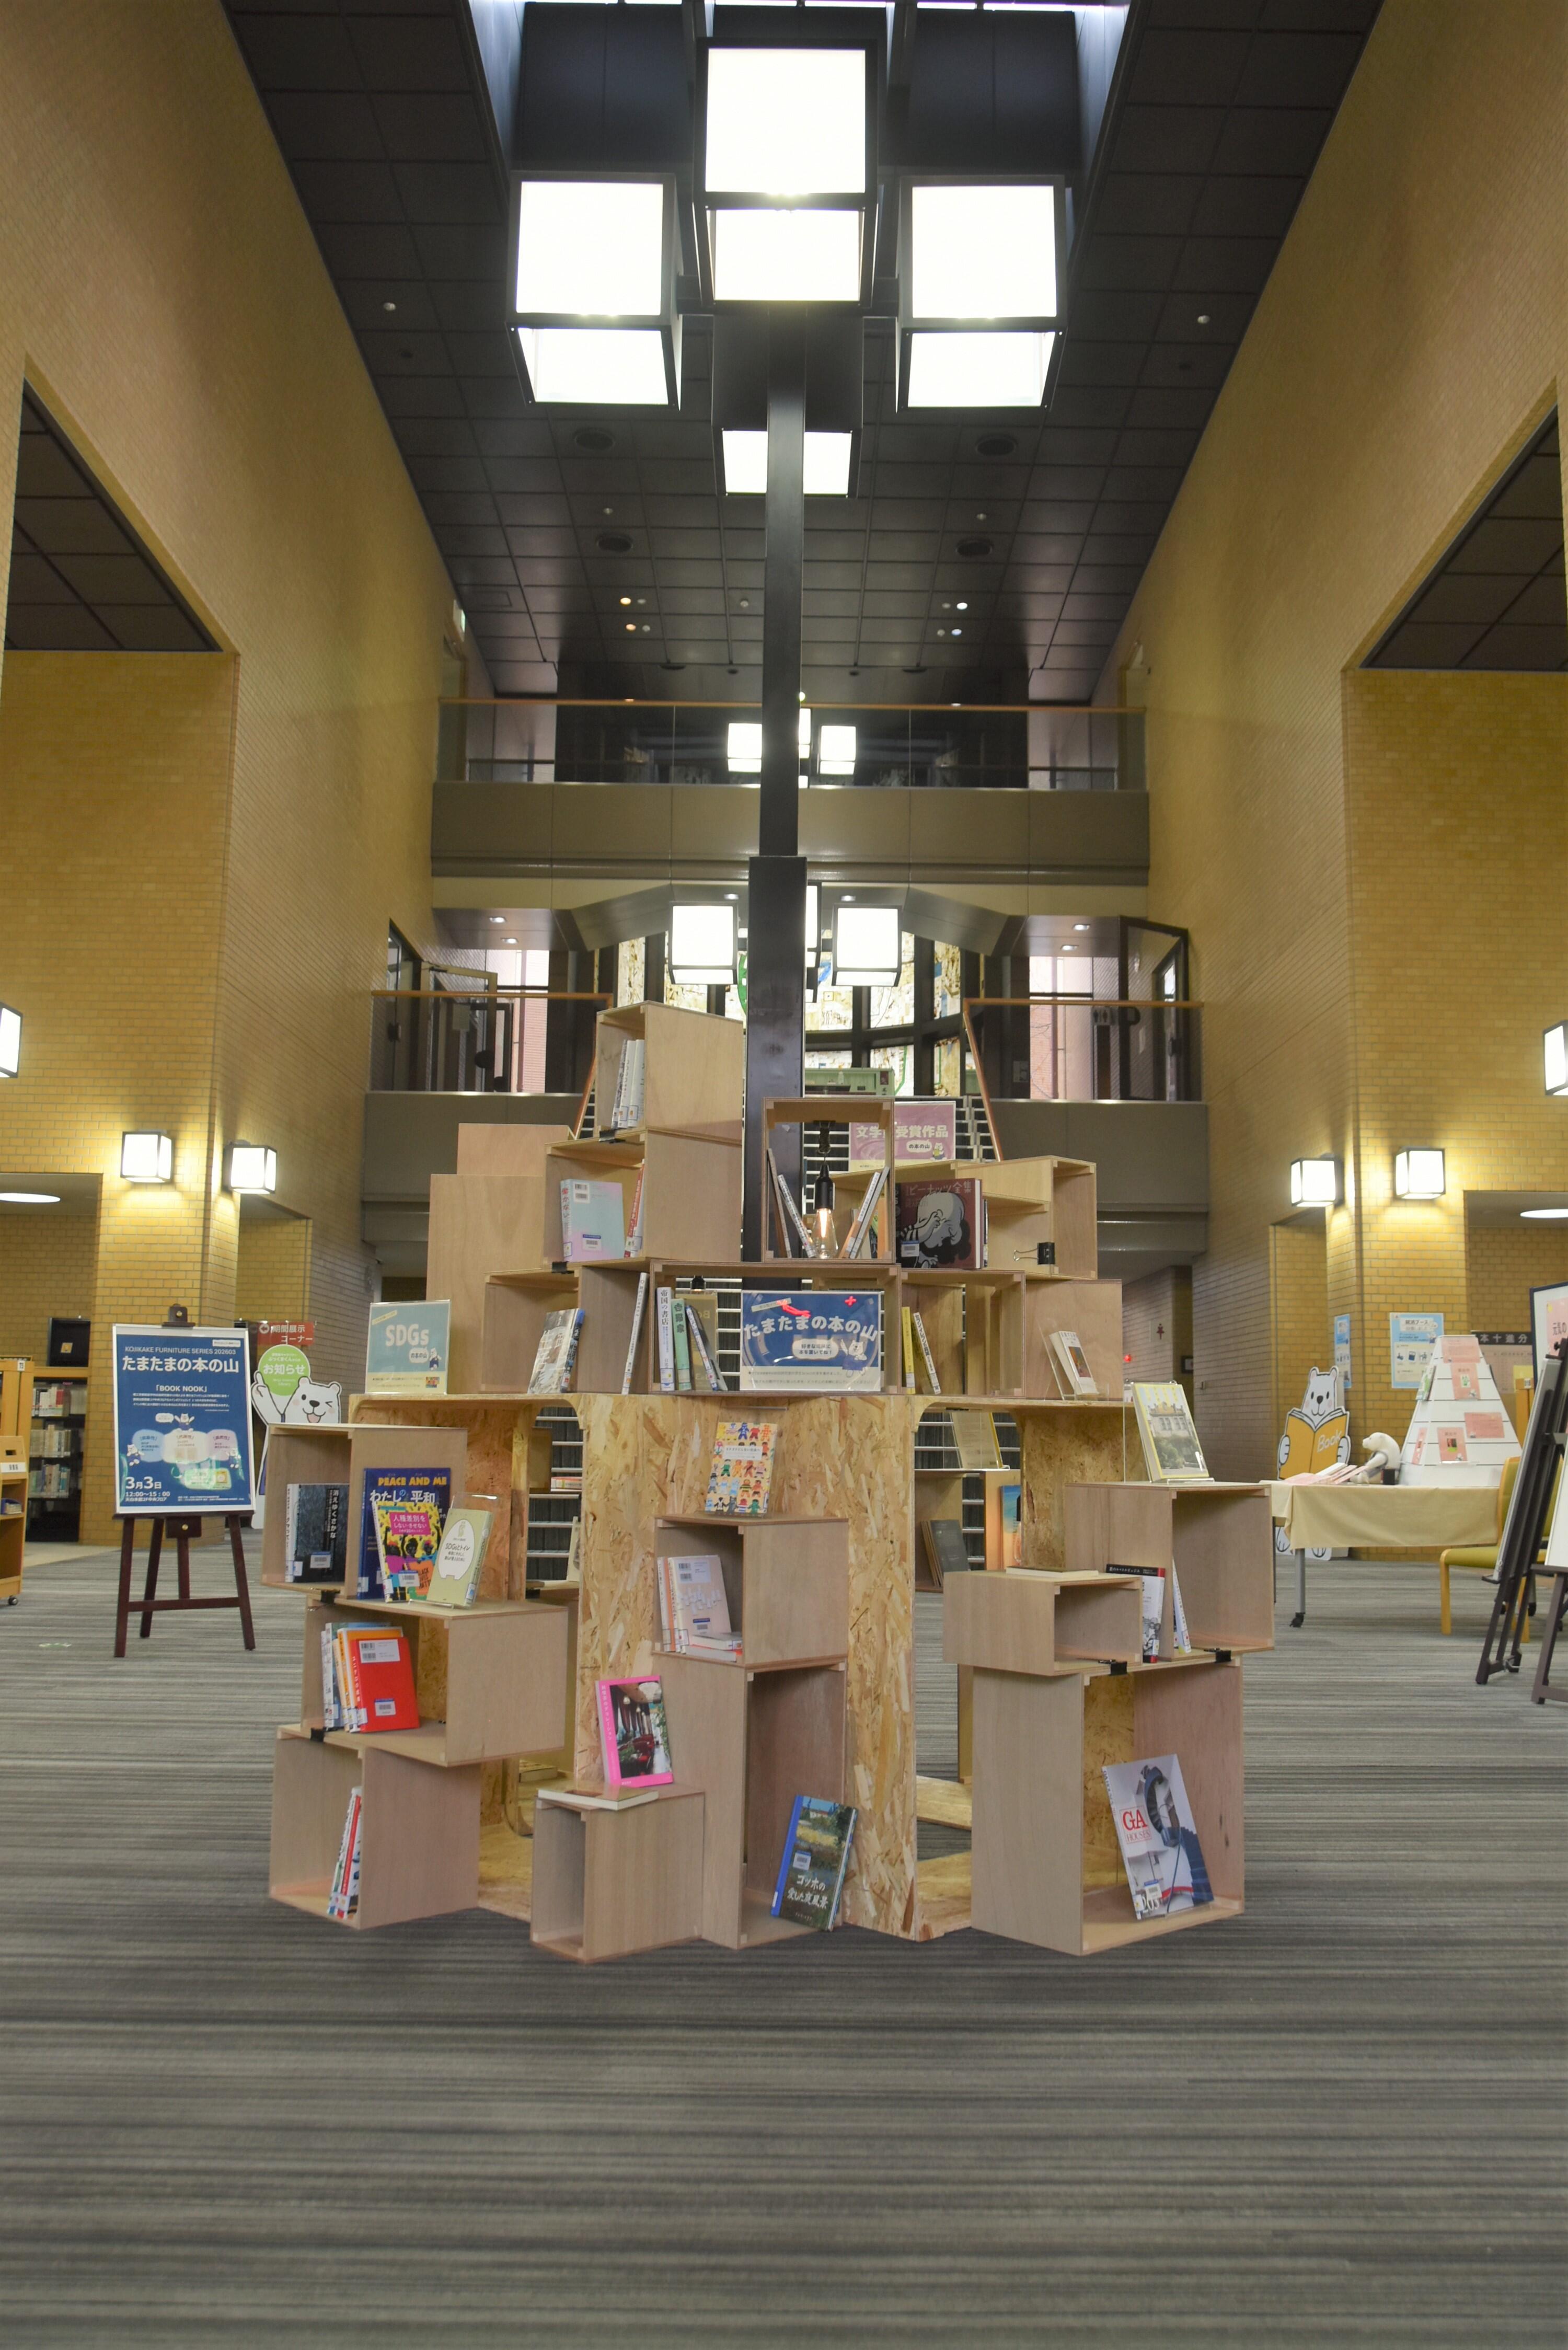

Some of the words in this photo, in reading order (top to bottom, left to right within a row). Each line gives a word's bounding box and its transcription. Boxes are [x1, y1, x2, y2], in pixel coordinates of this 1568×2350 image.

[660, 1289, 669, 1326] 帝国の書店
[271, 1324, 305, 1333] 期間展示
[385, 1323, 429, 1347] SDGs
[744, 1315, 878, 1341] たまたまの本の山
[122, 1355, 239, 1373] たまたまの本の山
[263, 1363, 306, 1375] お知らせ
[1317, 1430, 1342, 1453] Book
[125, 1476, 162, 1490] 3月3日
[378, 1477, 406, 1486] PEACE
[409, 1477, 430, 1485] AND
[433, 1477, 447, 1485] ME
[330, 1490, 339, 1539] 消えゆくさかな
[445, 1542, 470, 1551] SDGsとトイレ
[1123, 1808, 1148, 1831] GA
[1126, 1831, 1151, 1842] HOUSES
